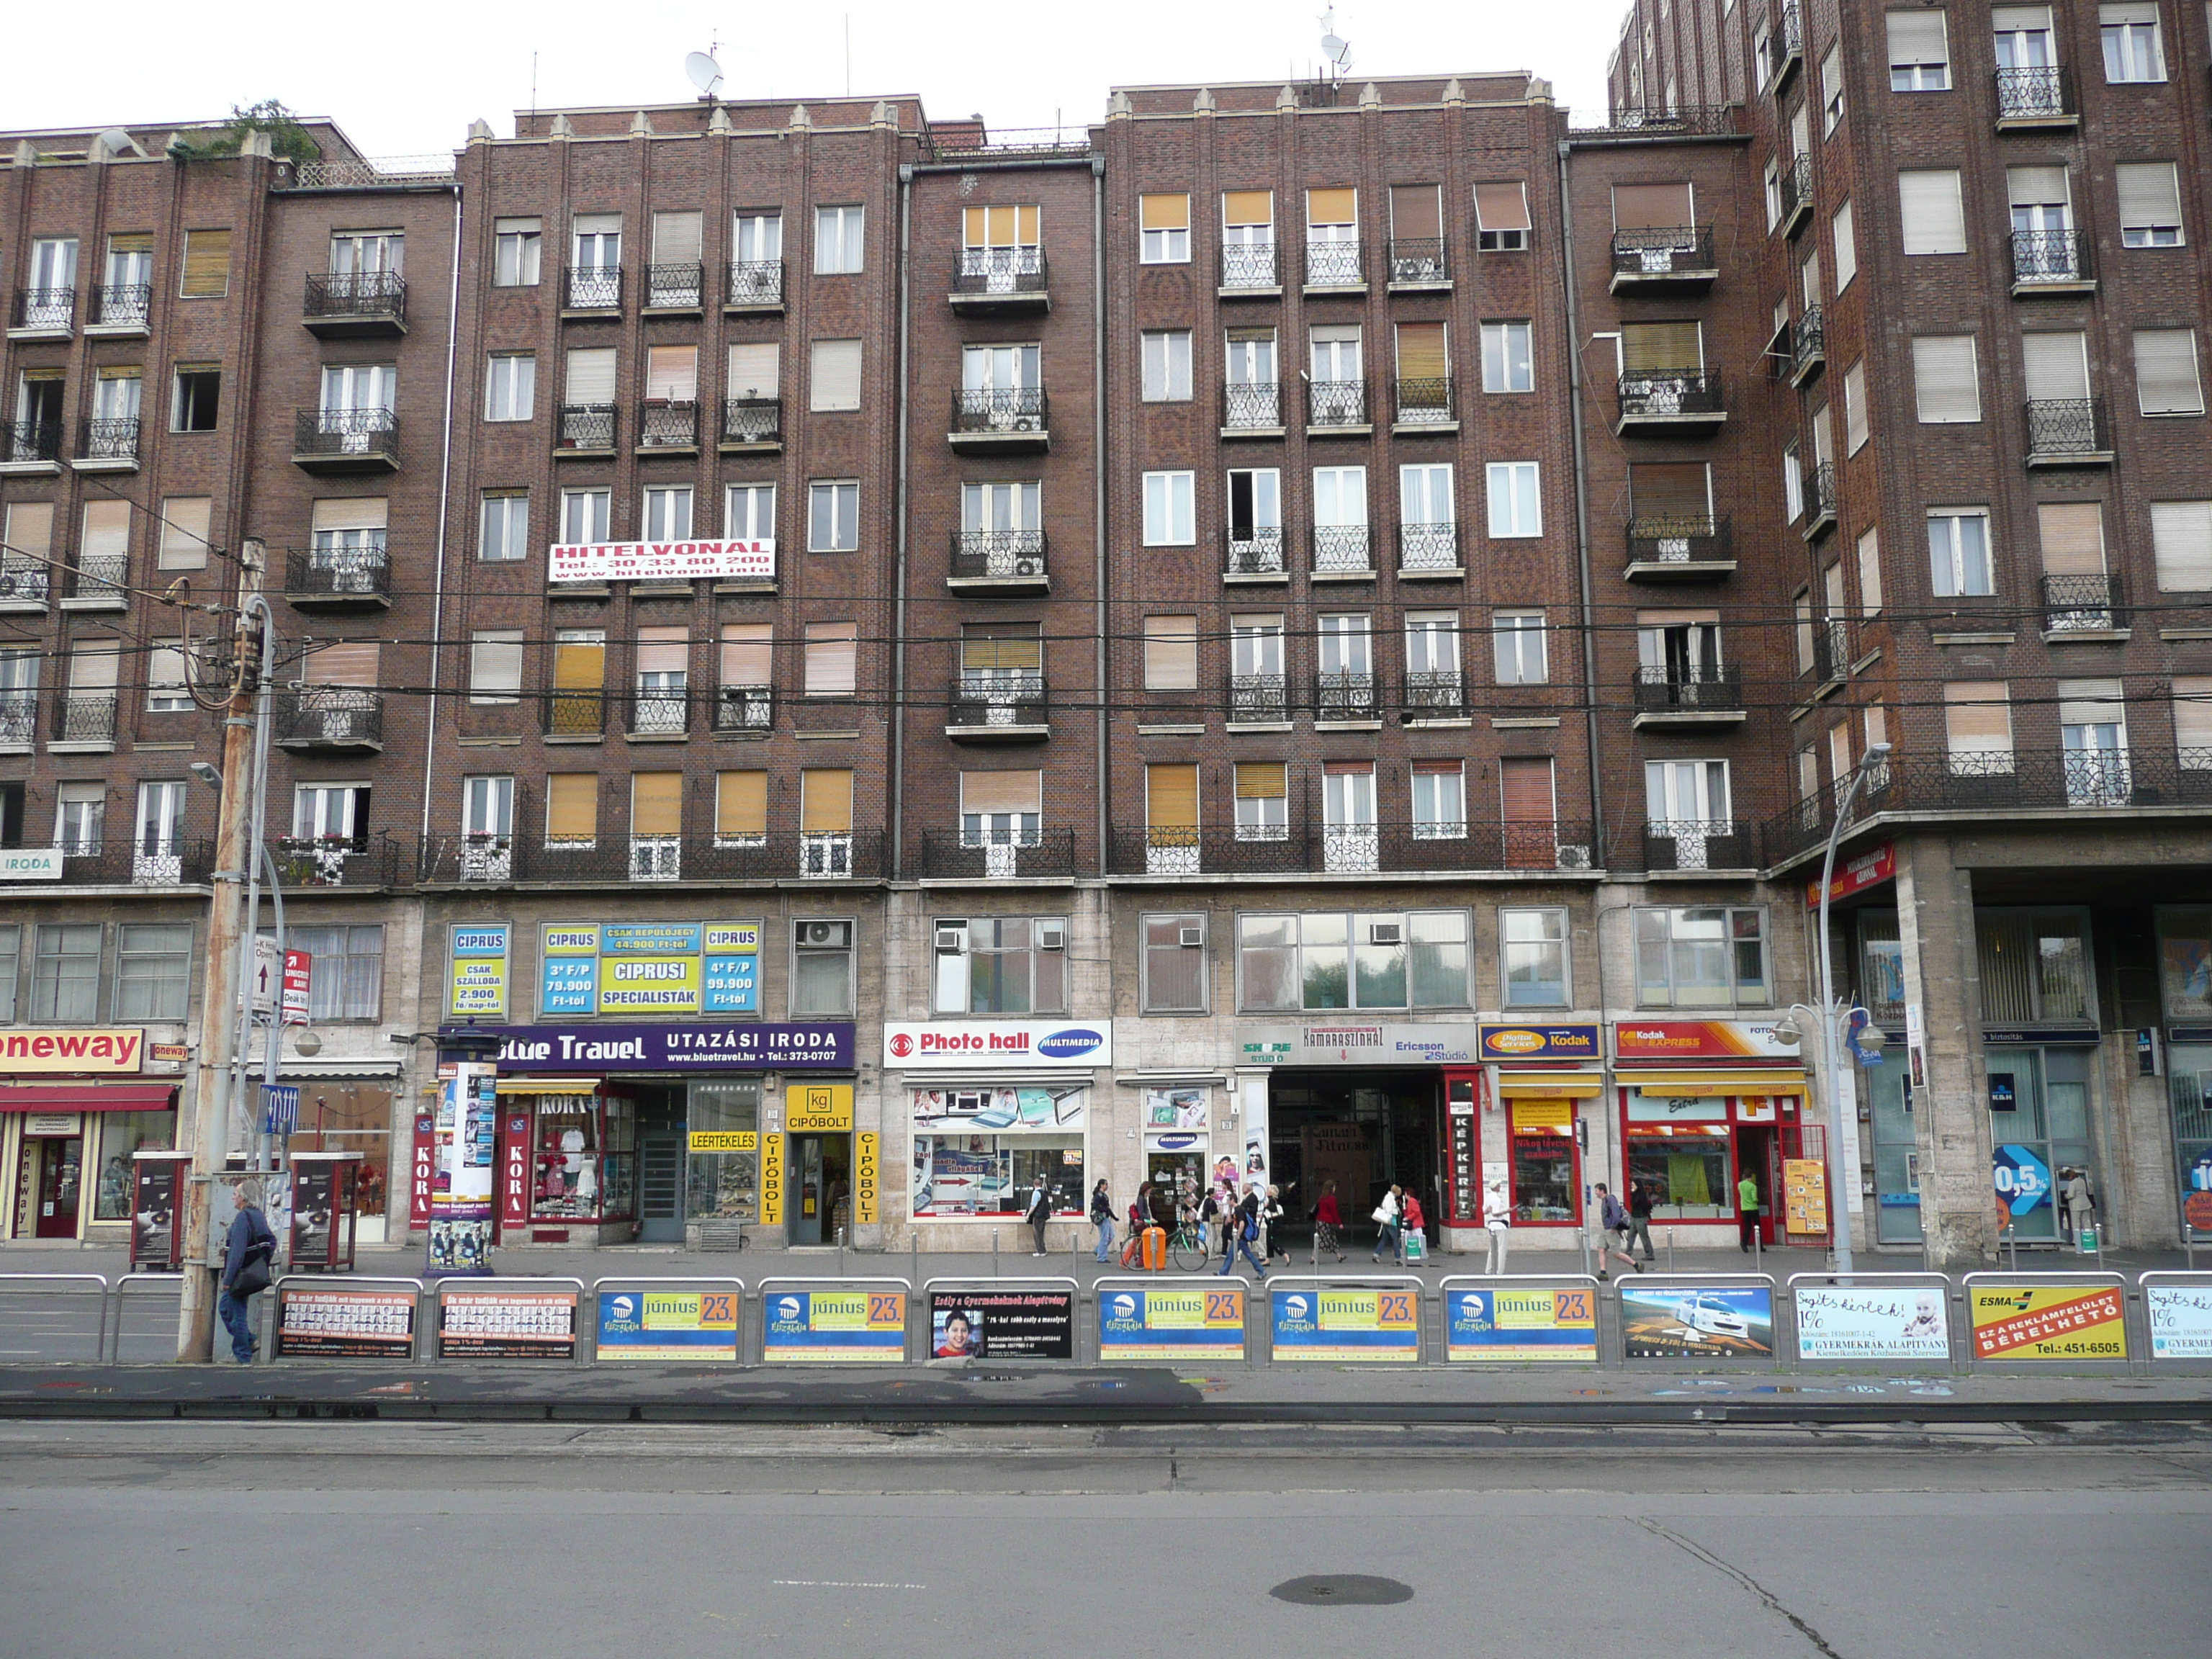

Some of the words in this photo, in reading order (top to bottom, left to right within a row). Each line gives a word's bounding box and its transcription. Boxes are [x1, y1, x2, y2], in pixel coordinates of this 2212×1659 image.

[554, 542, 770, 558] HITELVONAL
[725, 556, 769, 565] 200
[554, 567, 770, 578] www.hitelvonal.info
[6, 858, 50, 869] IRODA
[636, 926, 694, 937] REPÜLŐJEGY
[709, 932, 755, 943] CIPRUS
[457, 935, 503, 947] CIPRUS
[548, 935, 594, 945] CIPRUS
[615, 940, 655, 949] 44.900
[658, 938, 687, 948] Ft-tól
[567, 965, 590, 976] F/P
[614, 963, 685, 980] CIPRUSI
[728, 962, 750, 974] F/P
[457, 976, 500, 985] SZÁLLODA
[547, 981, 592, 992] 79.900
[708, 979, 752, 989] 99.900
[460, 990, 495, 999] 2.900
[553, 995, 585, 1005] Ft-tól
[603, 987, 695, 1003] SPECIALISTÁK
[714, 994, 745, 1004] Ft-tól
[667, 1030, 758, 1047] UTAZÁSI
[770, 1033, 836, 1047] IRODA
[921, 1033, 984, 1049] Photo
[989, 1033, 1029, 1048] hall
[1042, 1038, 1100, 1048] MULTIMEDIA
[1551, 1035, 1589, 1046] Kodak
[0, 1036, 138, 1064] neway
[156, 1046, 188, 1058] oneway
[558, 1035, 646, 1059] Travel
[1396, 1042, 1444, 1051] Ericsson
[667, 1052, 755, 1061] www.bluetravel.hu
[768, 1052, 787, 1061] Tel.:
[789, 1052, 836, 1061] 373-0707
[1434, 1051, 1467, 1061] Stúdió
[541, 1095, 586, 1114] KORA
[811, 1093, 827, 1109] kg
[1669, 1097, 1699, 1113] Extra
[789, 1115, 849, 1128] CIPŐBOLT
[692, 1133, 755, 1148] LEÉRTÉKELÉS
[1456, 1118, 1470, 1210] KÉPKERET
[414, 1147, 431, 1212] KORA
[508, 1146, 523, 1211] KORA
[765, 1135, 779, 1222] CIPŐBOLT
[860, 1133, 873, 1222] CIPŐBOLT
[19, 1148, 30, 1223] oneway
[447, 1295, 457, 1304] Ők
[935, 1297, 956, 1307] Esély
[1798, 1292, 1838, 1308] Segíts
[1979, 1297, 2011, 1306] ESMA
[644, 1300, 698, 1315] június
[703, 1297, 732, 1321] 23.
[811, 1300, 865, 1315] június
[870, 1298, 901, 1321] 23.
[1148, 1298, 1202, 1313] június
[1208, 1295, 1238, 1319] 23.
[1321, 1300, 1375, 1314] június
[1381, 1296, 1412, 1321] 23.
[1496, 1298, 1552, 1313] június
[1557, 1295, 1589, 1319] 23.
[1799, 1310, 1824, 1328] 1%
[1979, 1329, 1996, 1339] EZ
[2008, 1296, 2113, 1331] REKLÁMFELÜLET
[2151, 1308, 2176, 1327] 1%
[1982, 1305, 2117, 1350] BÉRELHETŐ
[1815, 1339, 1884, 1349] GYERMEKRÁK
[1888, 1339, 1947, 1349] ALAPÍTVÁNY
[2036, 1344, 2062, 1353] Tel.:
[2064, 1343, 2120, 1353] 451-6505
[2168, 1339, 2212, 1348] GYERME
